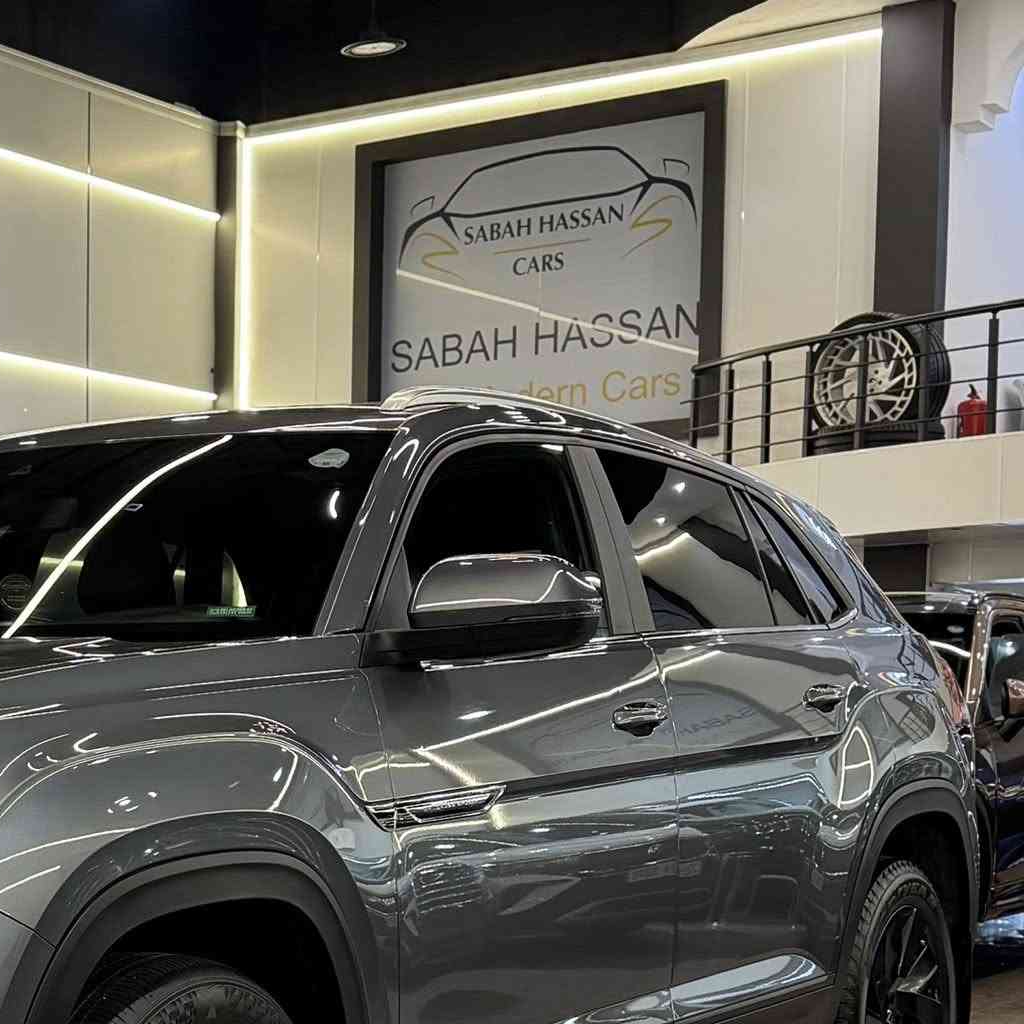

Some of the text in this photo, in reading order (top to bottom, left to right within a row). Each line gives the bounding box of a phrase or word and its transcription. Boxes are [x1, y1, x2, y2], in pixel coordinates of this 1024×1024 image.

[463, 203, 625, 246] SABAH HASSAN
[512, 251, 566, 276] CARS
[391, 303, 700, 373] SABAH HASSAN
[602, 370, 682, 403] Cars
